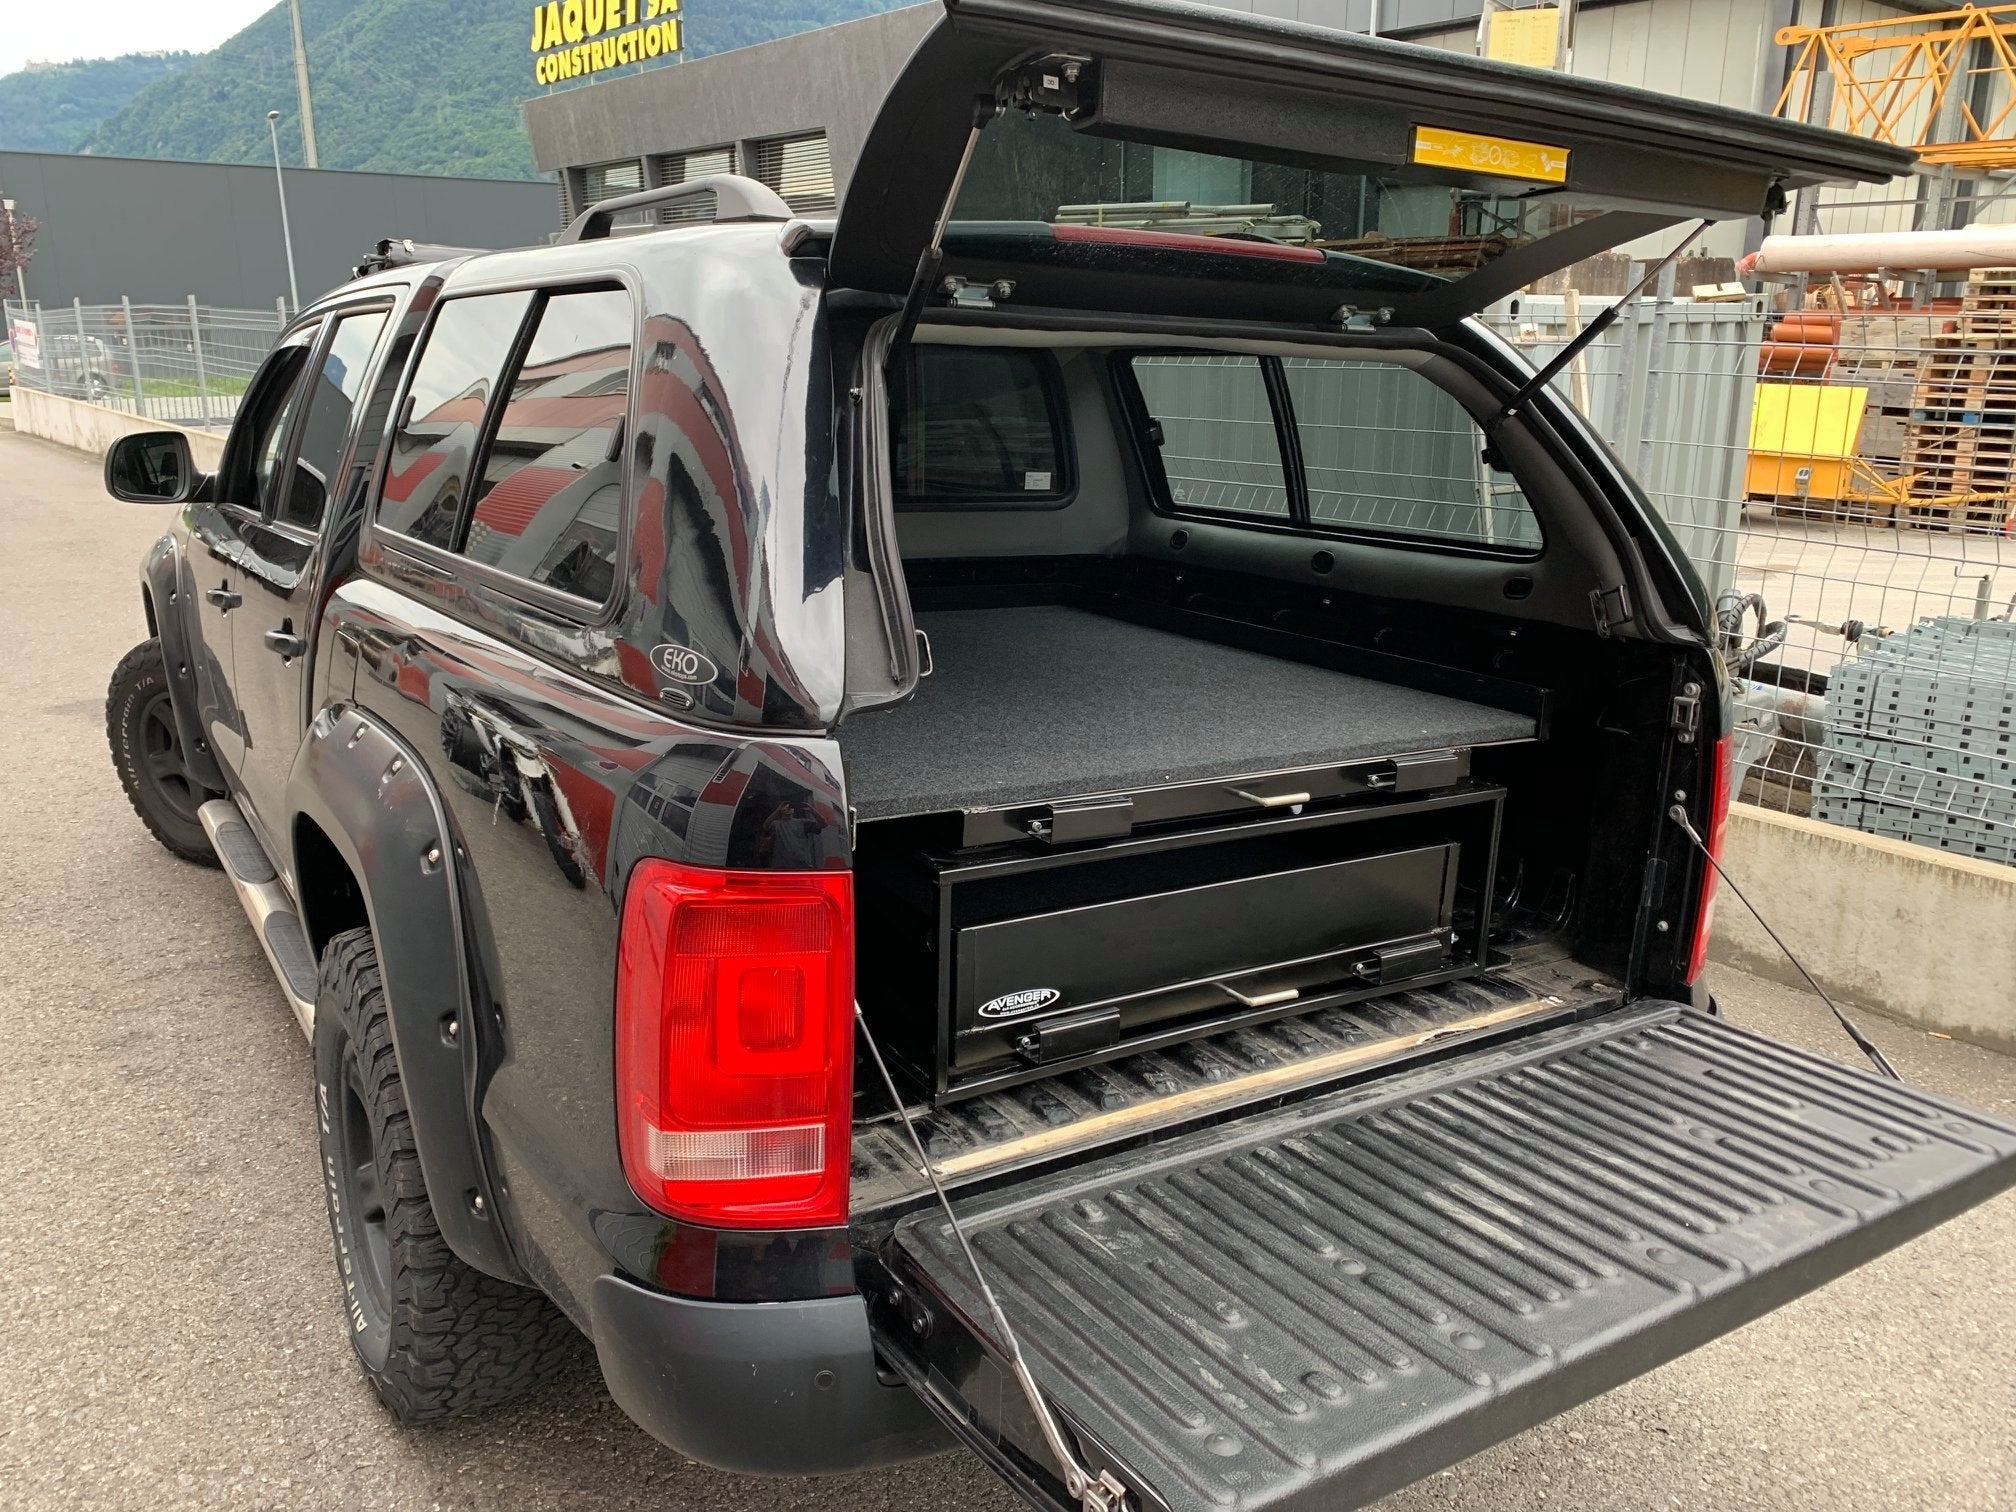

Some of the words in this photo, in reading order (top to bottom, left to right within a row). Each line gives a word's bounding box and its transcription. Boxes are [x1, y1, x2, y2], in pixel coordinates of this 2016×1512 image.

[536, 19, 678, 85] CONSTRUCTION
[663, 648, 698, 675] EKO
[134, 675, 155, 691] T/A
[987, 990, 1051, 1011] AVENGER
[319, 1082, 330, 1135] T/A
[326, 1155, 369, 1334] All-Terrain
